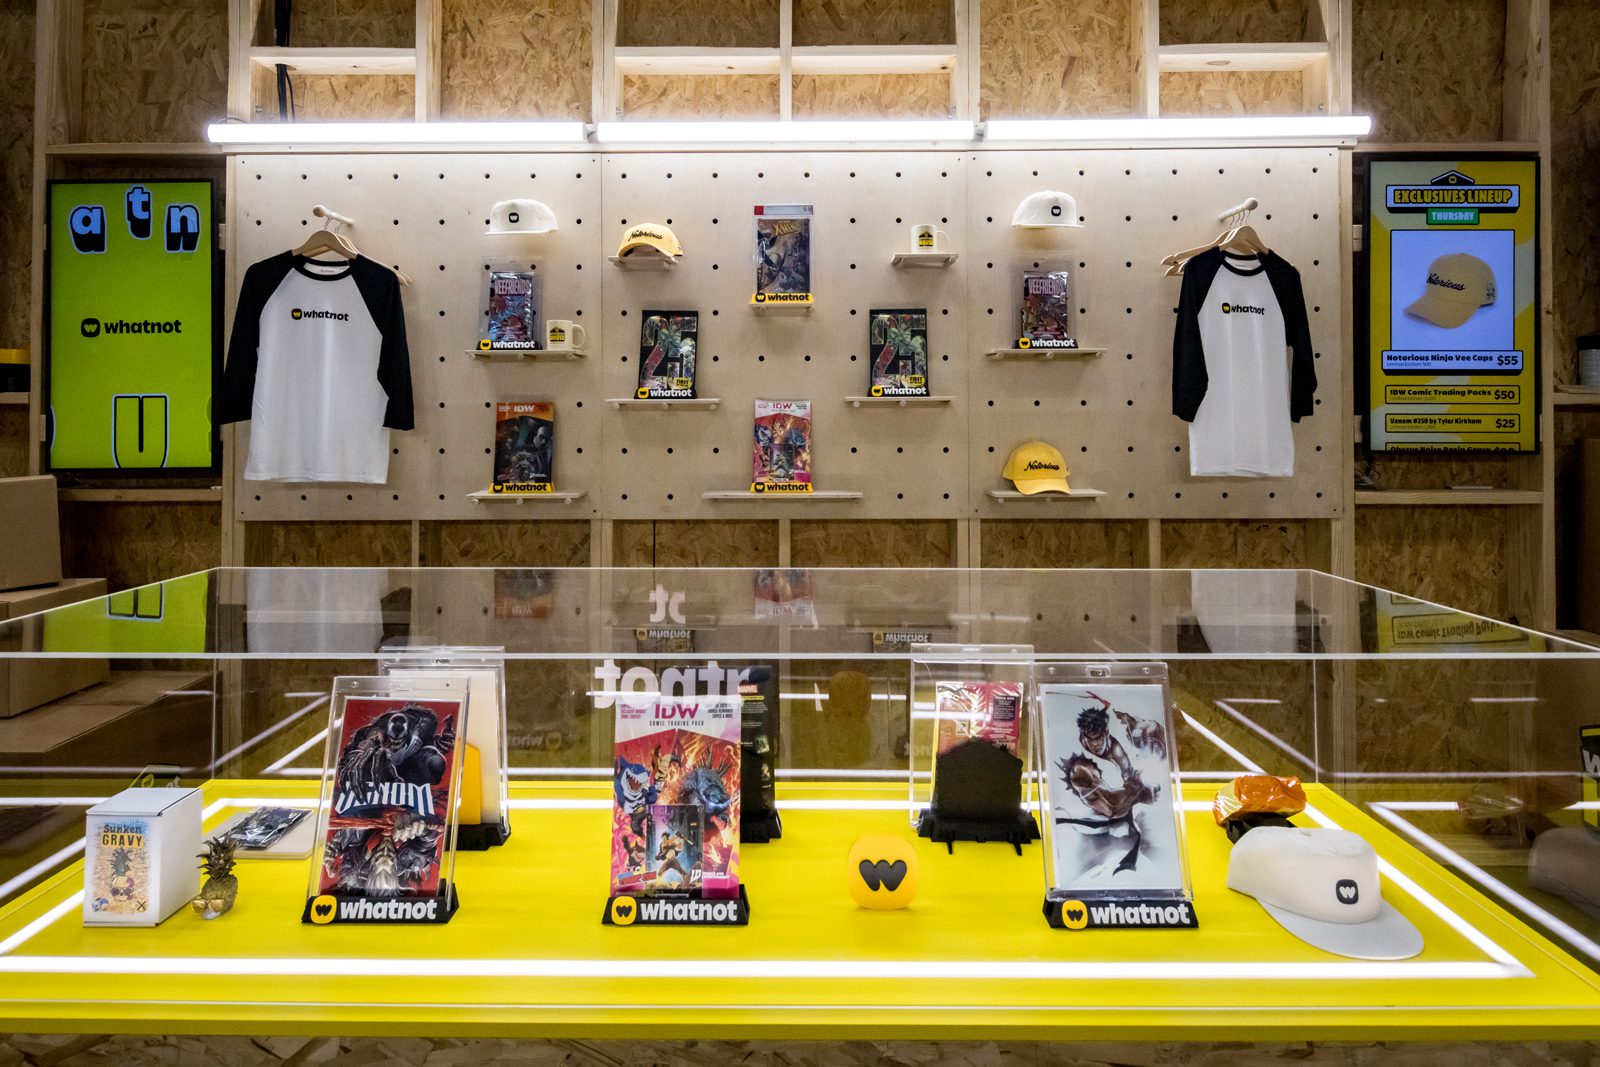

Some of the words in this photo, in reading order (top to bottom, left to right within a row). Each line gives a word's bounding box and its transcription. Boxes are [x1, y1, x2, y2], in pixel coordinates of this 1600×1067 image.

[1394, 189, 1465, 203] EXCLUSIVES
[1467, 189, 1512, 203] LINEUP
[1432, 211, 1474, 221] THURSDAY
[1427, 272, 1466, 291] Notorious
[767, 293, 809, 302] whatnot
[303, 309, 349, 322] whatnot
[1231, 304, 1265, 316] whatnot
[104, 319, 182, 334] whatnot
[492, 339, 536, 350] whatnot
[1031, 338, 1075, 347] whatnot
[1431, 354, 1452, 363] Ninja
[1472, 354, 1494, 363] Caps
[1497, 355, 1518, 366] $55
[650, 388, 692, 397] whatnot
[884, 386, 927, 395] whatnot
[1433, 389, 1466, 397] Trading
[1494, 389, 1515, 400] $50
[513, 405, 535, 413] IDW
[772, 402, 793, 410] IDW
[1429, 418, 1437, 426] by
[1438, 418, 1453, 426] Tyler
[1495, 418, 1515, 429] $25
[1024, 460, 1060, 471] Notorious
[505, 483, 547, 492] whatnot
[767, 483, 809, 491] whatnot
[655, 703, 699, 719] IDW
[103, 823, 142, 834] Sunken
[102, 834, 143, 847] GRAVY
[340, 899, 437, 920] whatnot
[640, 900, 738, 922] whatnot
[1090, 902, 1190, 925] whatnot
